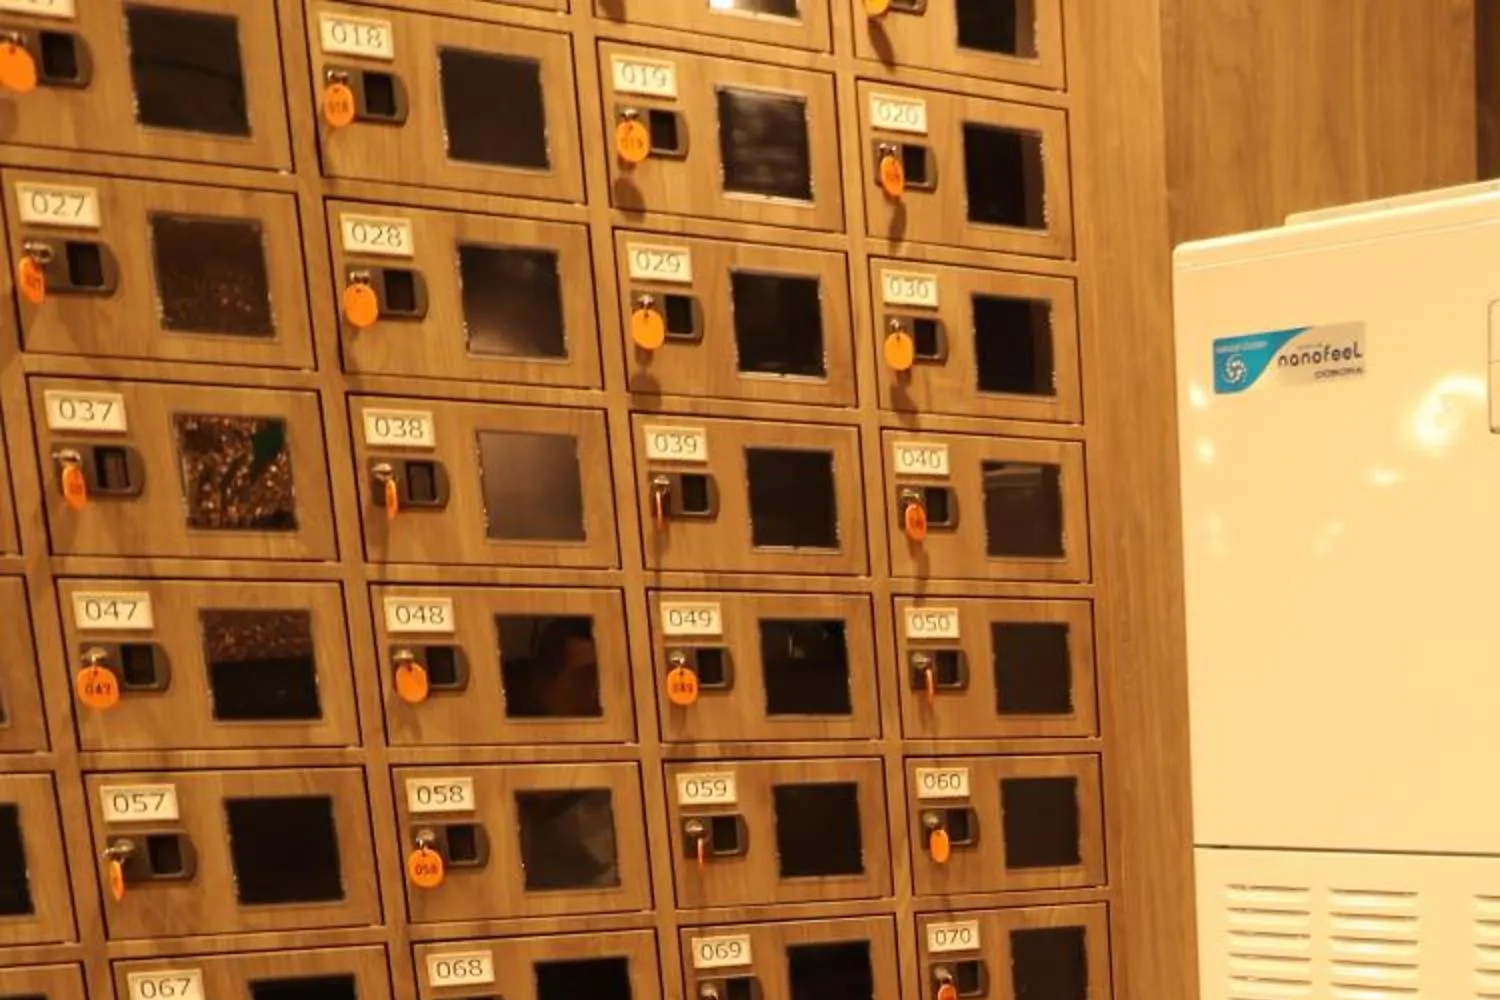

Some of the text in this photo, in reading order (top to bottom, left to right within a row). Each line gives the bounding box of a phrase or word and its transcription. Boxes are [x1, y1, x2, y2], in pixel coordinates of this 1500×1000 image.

[331, 23, 383, 49] 018
[621, 65, 667, 88] 019
[878, 102, 919, 124] 020
[30, 193, 87, 217] 027
[351, 223, 403, 248] 028
[635, 251, 681, 273] 029
[890, 279, 929, 299] 030
[59, 399, 114, 422] 037
[374, 419, 424, 439] 038
[654, 434, 698, 454] 039
[901, 450, 941, 470] 040
[85, 600, 139, 621] 047
[395, 606, 444, 624] 048
[669, 610, 713, 628] 049
[912, 613, 951, 631] 050
[685, 780, 728, 799] 059
[924, 773, 962, 791] 060
[113, 793, 167, 814] 057
[416, 785, 465, 805] 058
[934, 928, 972, 946] 070
[701, 941, 743, 960] 069
[436, 960, 484, 979] 068
[141, 978, 192, 999] 067
